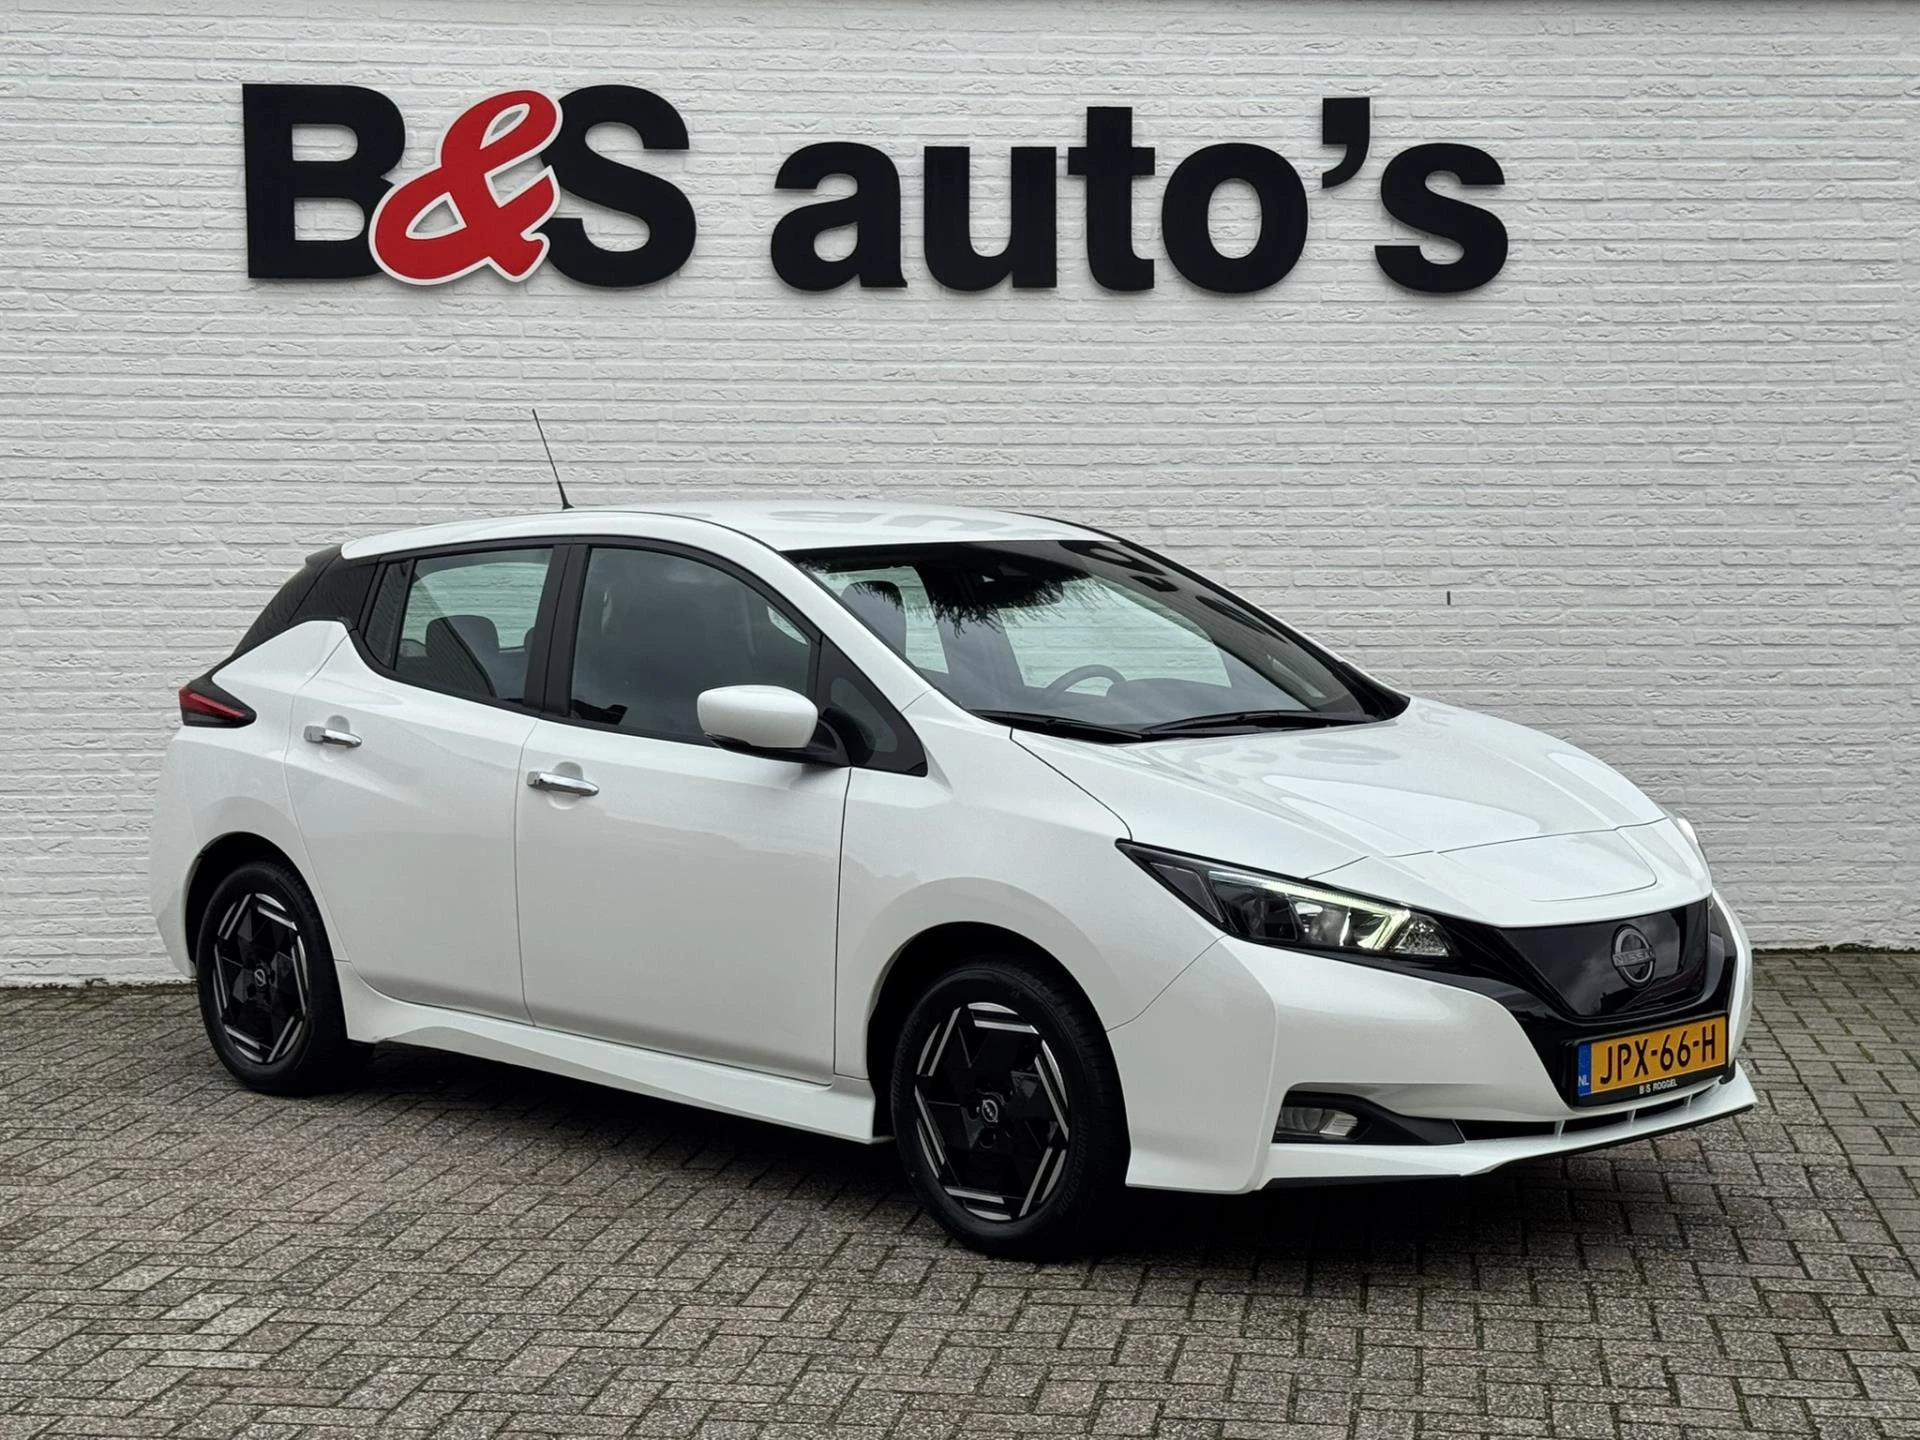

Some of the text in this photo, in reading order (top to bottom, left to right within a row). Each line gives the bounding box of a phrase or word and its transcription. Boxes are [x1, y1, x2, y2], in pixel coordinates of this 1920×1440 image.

[243, 84, 1508, 297] B&S auto's
[1577, 1075, 1590, 1087] NL
[1600, 1024, 1716, 1085] JPX-66-H
